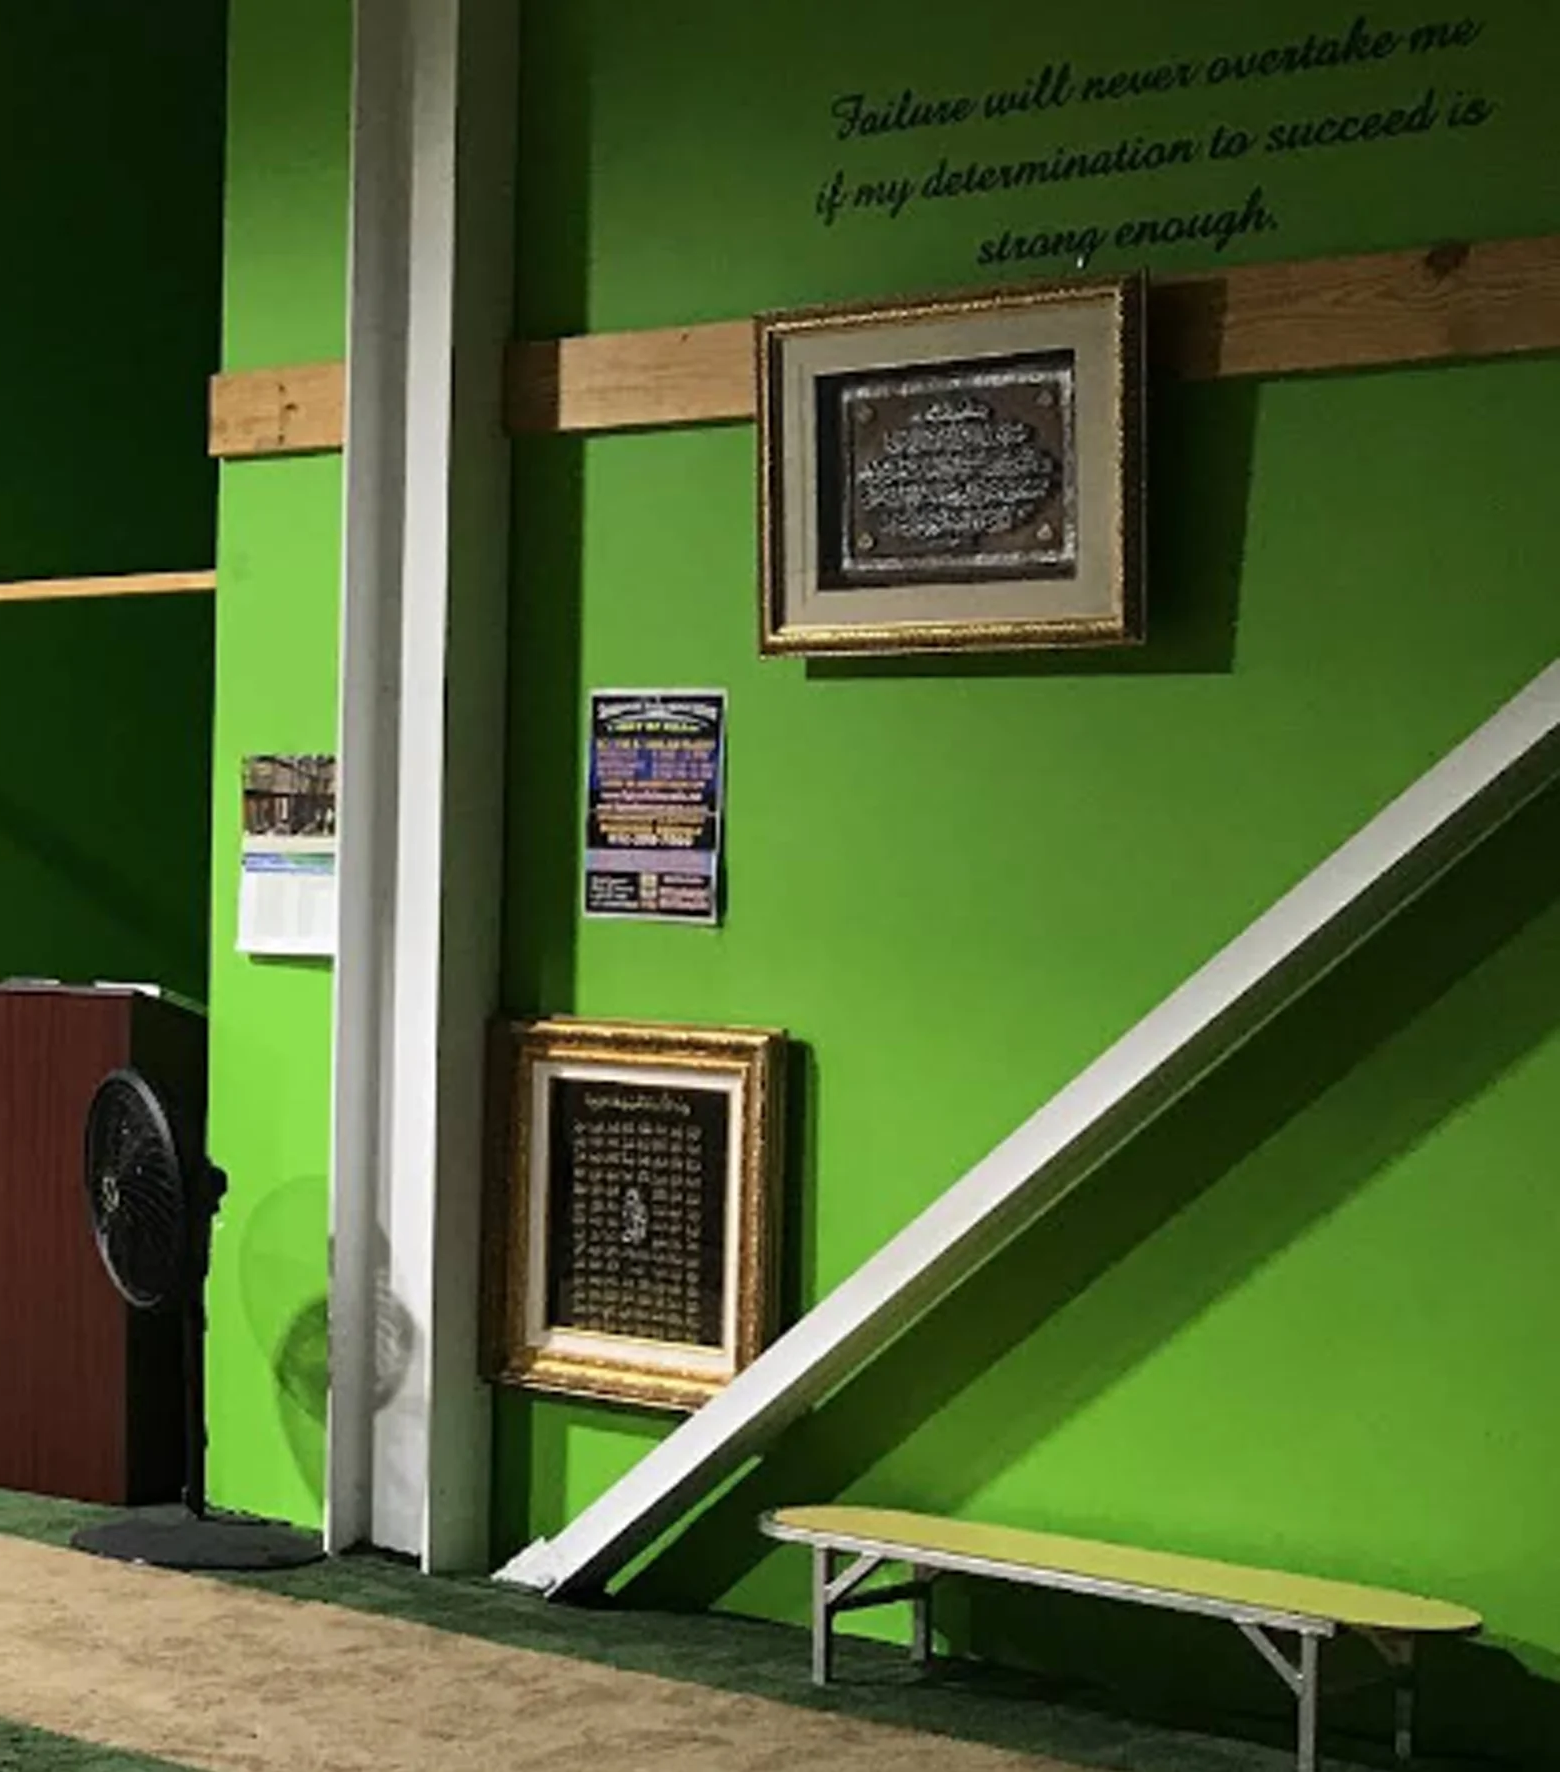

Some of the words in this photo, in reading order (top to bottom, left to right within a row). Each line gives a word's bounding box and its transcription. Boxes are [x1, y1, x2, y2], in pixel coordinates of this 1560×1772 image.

[832, 87, 977, 141] Failure
[984, 60, 1076, 119] will
[1080, 61, 1197, 101] never
[1205, 14, 1403, 85] overtake
[1408, 16, 1485, 54] me
[815, 168, 849, 228] if
[853, 178, 915, 220] my
[921, 135, 1201, 200] determination
[1208, 124, 1257, 160] to
[1263, 87, 1439, 153] succeed
[1446, 90, 1499, 128] is
[976, 225, 1109, 270] strong
[1112, 184, 1279, 254] enough.
